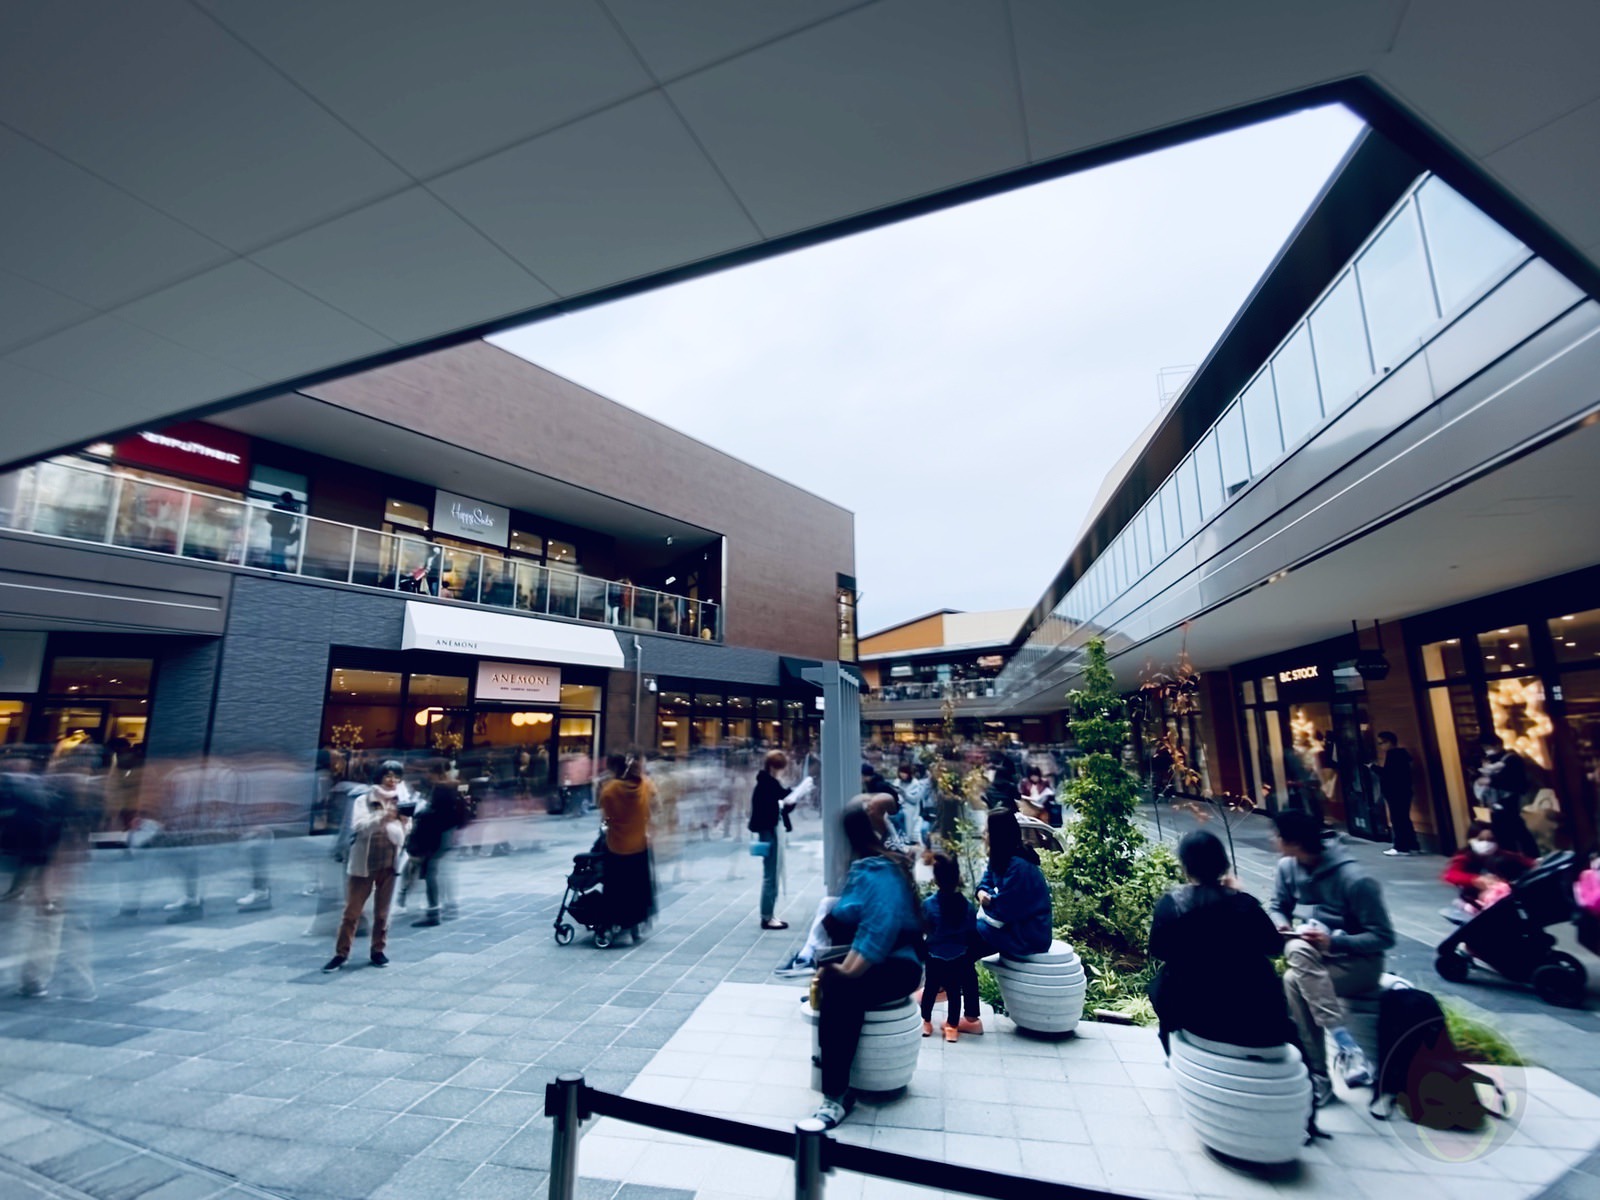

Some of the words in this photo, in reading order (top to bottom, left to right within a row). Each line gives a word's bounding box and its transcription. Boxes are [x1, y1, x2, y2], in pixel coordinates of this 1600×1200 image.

[436, 639, 477, 649] ANEMONE
[492, 673, 549, 686] ANEMONE
[1292, 666, 1318, 681] STOCK
